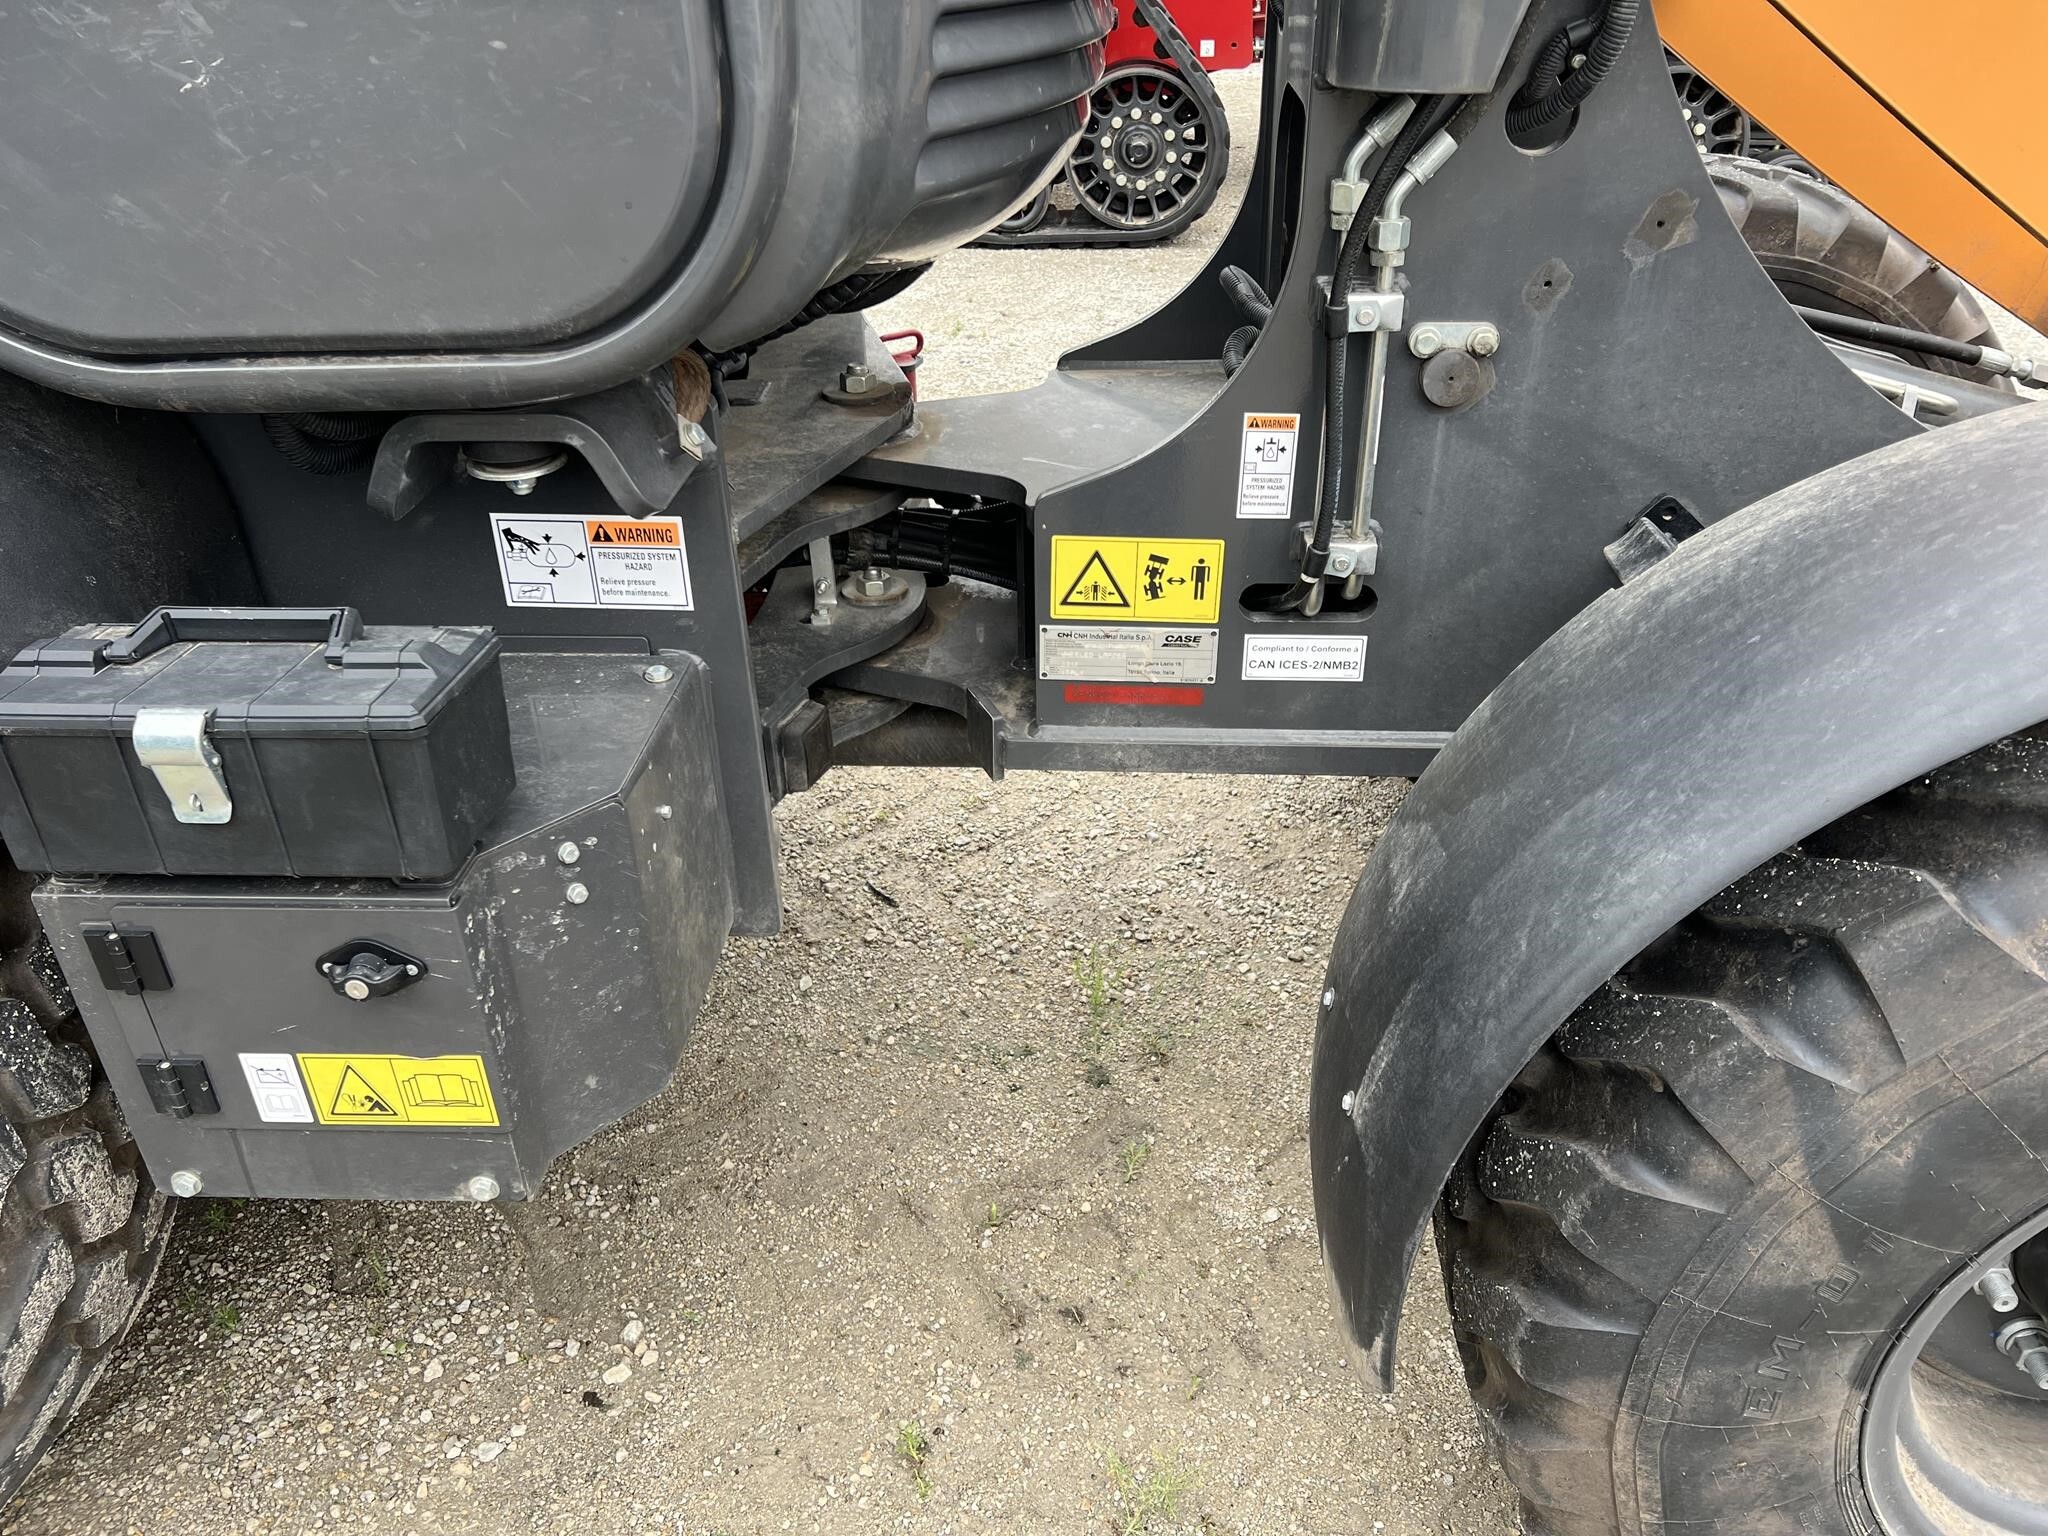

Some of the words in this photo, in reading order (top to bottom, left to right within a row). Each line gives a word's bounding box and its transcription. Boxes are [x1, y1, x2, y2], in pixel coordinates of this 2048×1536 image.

[1261, 419, 1294, 429] WARNING
[614, 527, 673, 543] WARNING
[598, 551, 645, 561] PRESSURIZED
[647, 552, 677, 561] SYSTEM
[625, 562, 653, 571] HAZARD
[600, 577, 626, 586] Relieve
[627, 578, 657, 587] pressure
[602, 587, 624, 596] before
[625, 588, 671, 597] maintenance.
[1073, 632, 1088, 640] CNH
[1165, 635, 1202, 643] CASE
[1252, 645, 1294, 653] Compliant
[1311, 645, 1352, 653] Conforme
[1249, 660, 1275, 669] CAN
[1279, 660, 1358, 670] ICES-2/NMB2
